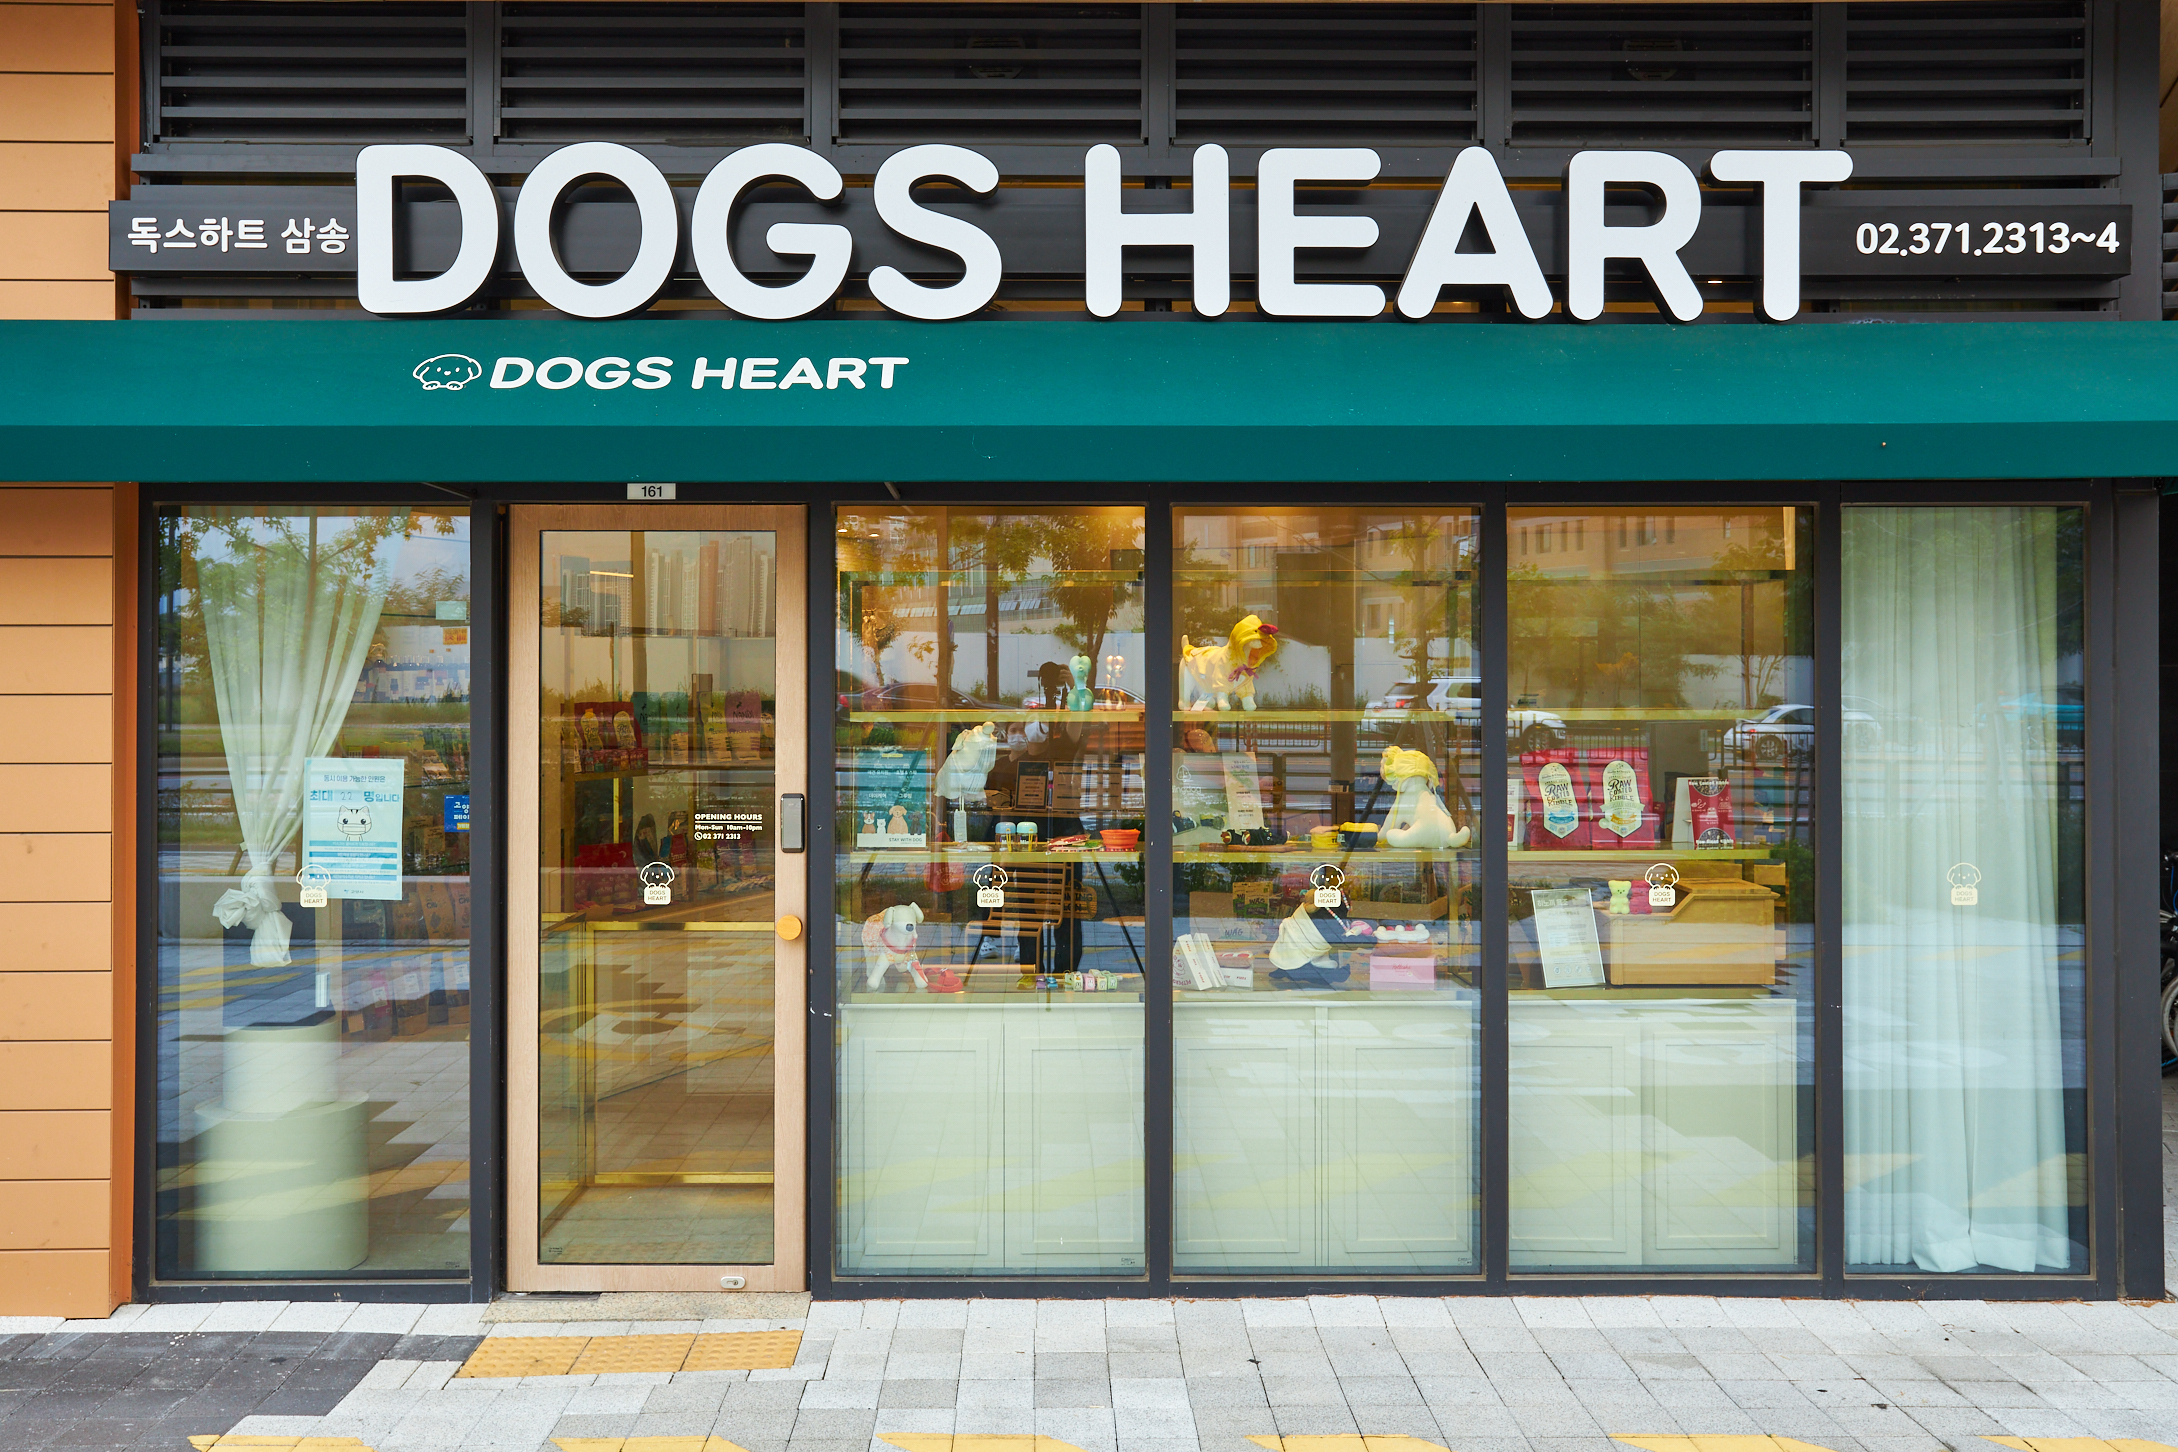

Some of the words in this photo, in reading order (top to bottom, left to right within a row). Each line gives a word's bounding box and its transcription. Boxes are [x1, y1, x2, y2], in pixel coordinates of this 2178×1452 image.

[126, 216, 269, 254] 독스하트
[280, 216, 350, 254] 삼송
[355, 141, 1003, 320] DOGS
[1083, 143, 1855, 323] HEART
[1855, 221, 2120, 258] 02.371.2313~4
[489, 356, 673, 391] DOGS
[690, 356, 909, 391] HEART
[641, 485, 663, 498] 161
[349, 775, 367, 783] 가능한
[1607, 778, 1632, 792] RAW
[310, 790, 333, 802] 최대
[340, 791, 353, 801] 22
[364, 791, 400, 802] 명입니다
